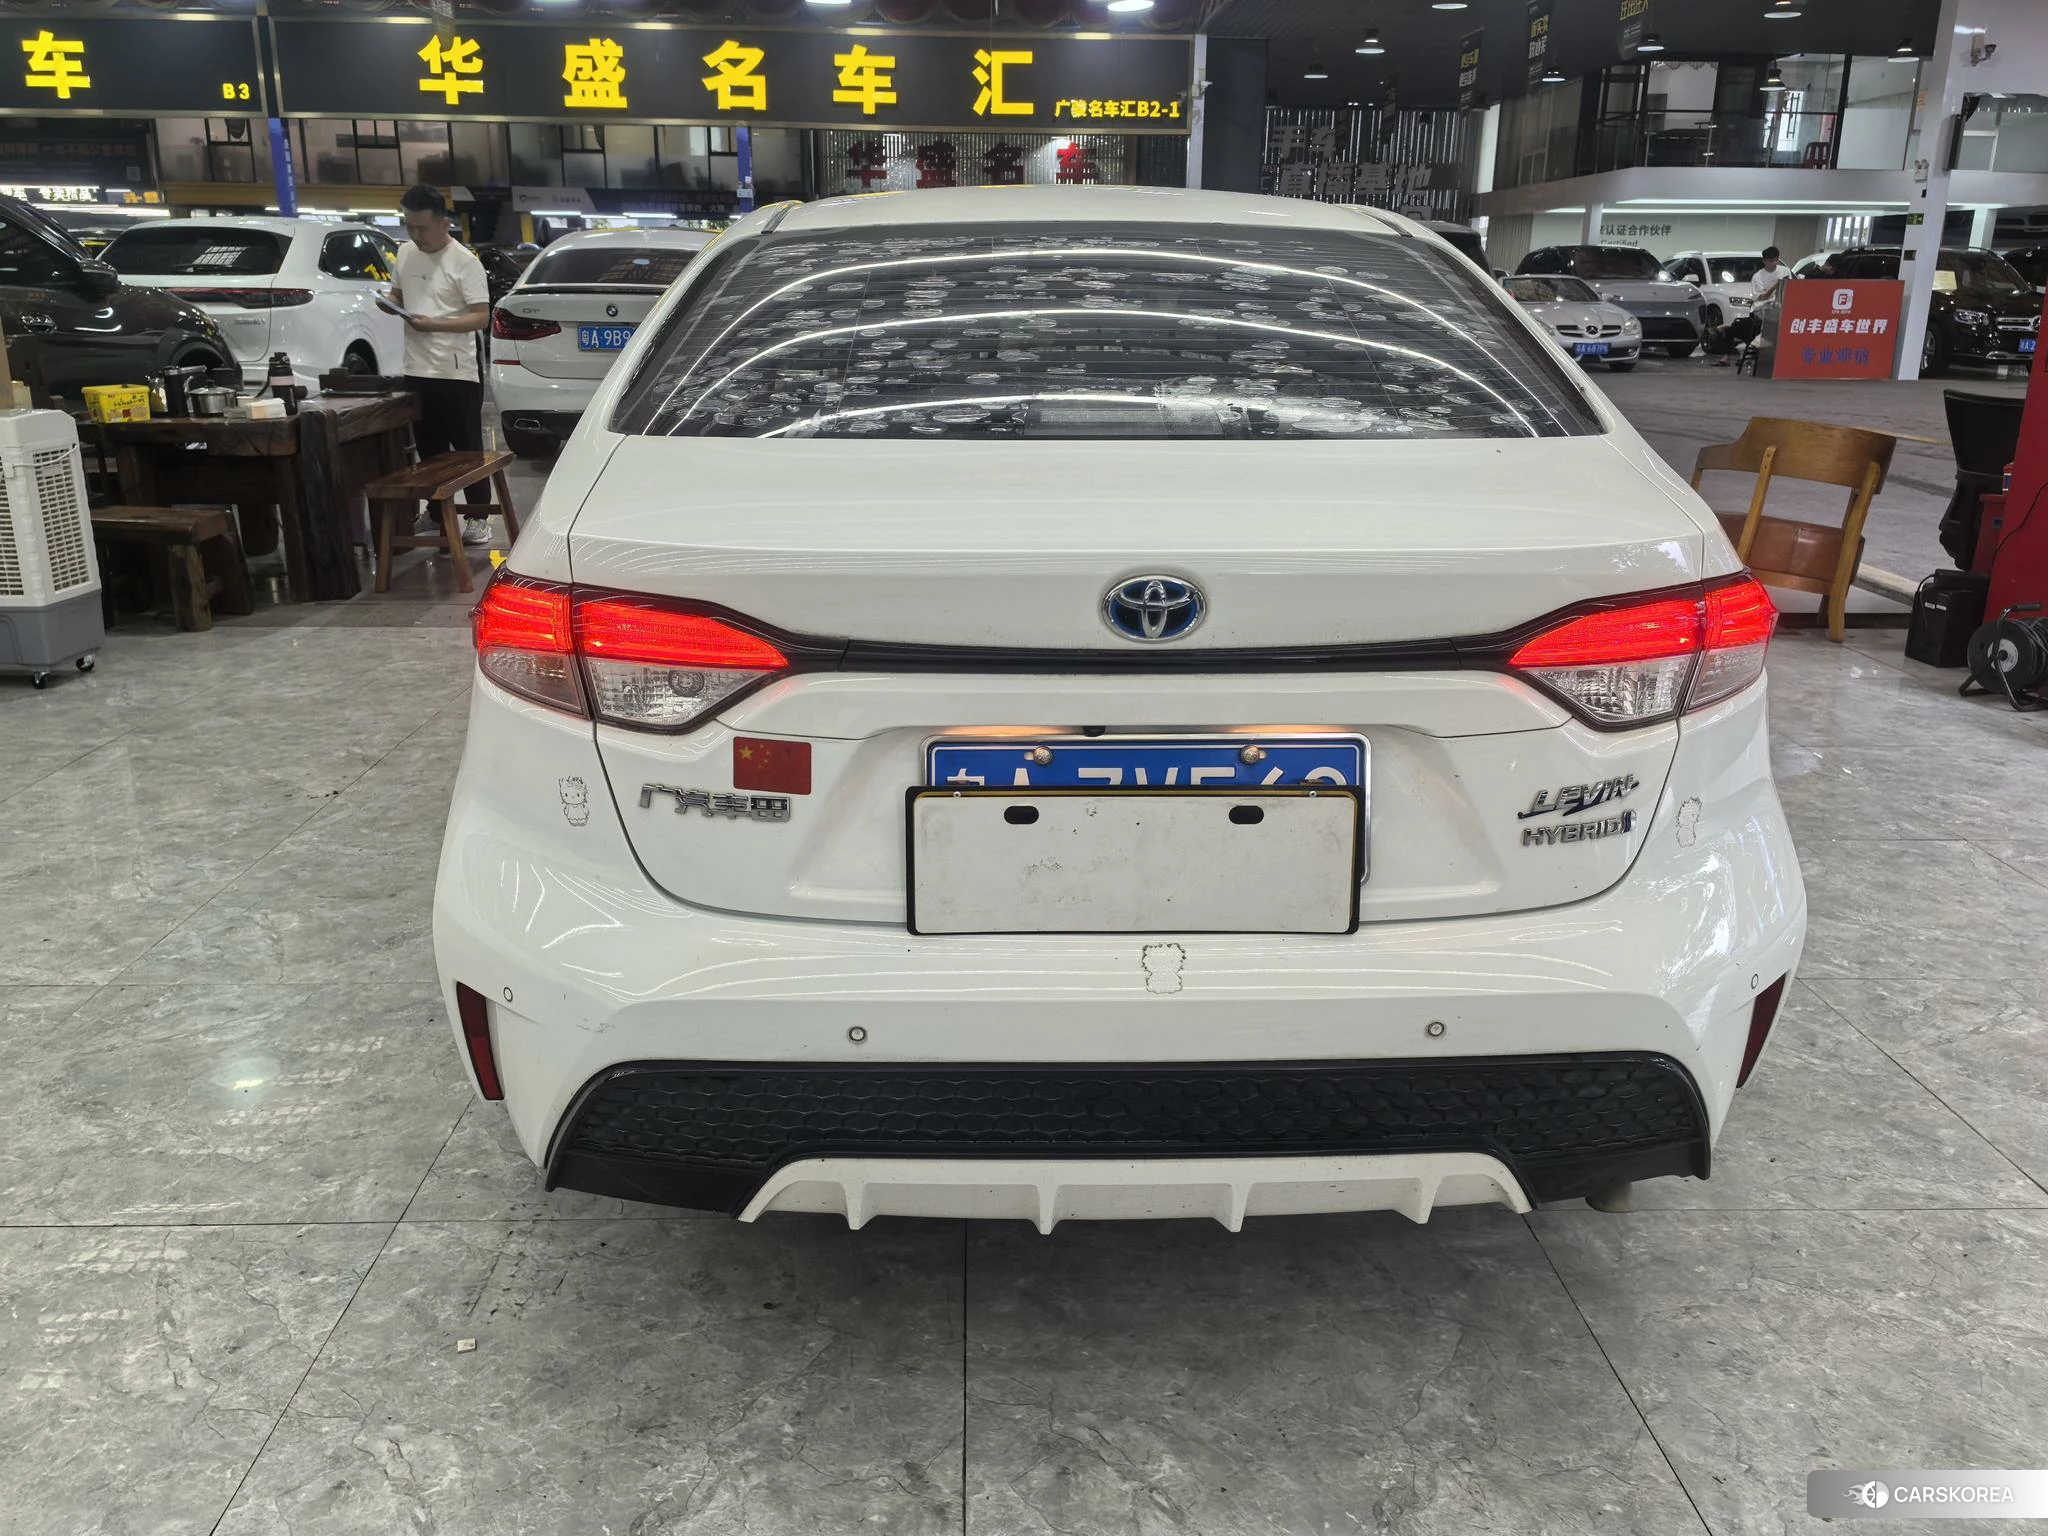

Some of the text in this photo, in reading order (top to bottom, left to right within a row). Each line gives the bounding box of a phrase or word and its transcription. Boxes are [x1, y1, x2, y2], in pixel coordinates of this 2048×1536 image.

[22, 30, 91, 99] 车
[417, 34, 1035, 117] 华盛名车汇
[1790, 318, 1888, 334] 创丰盛车世界
[639, 784, 791, 823] 广汽丰田
[1522, 774, 1640, 815] LEVIN
[1522, 817, 1624, 847] HYBRID
